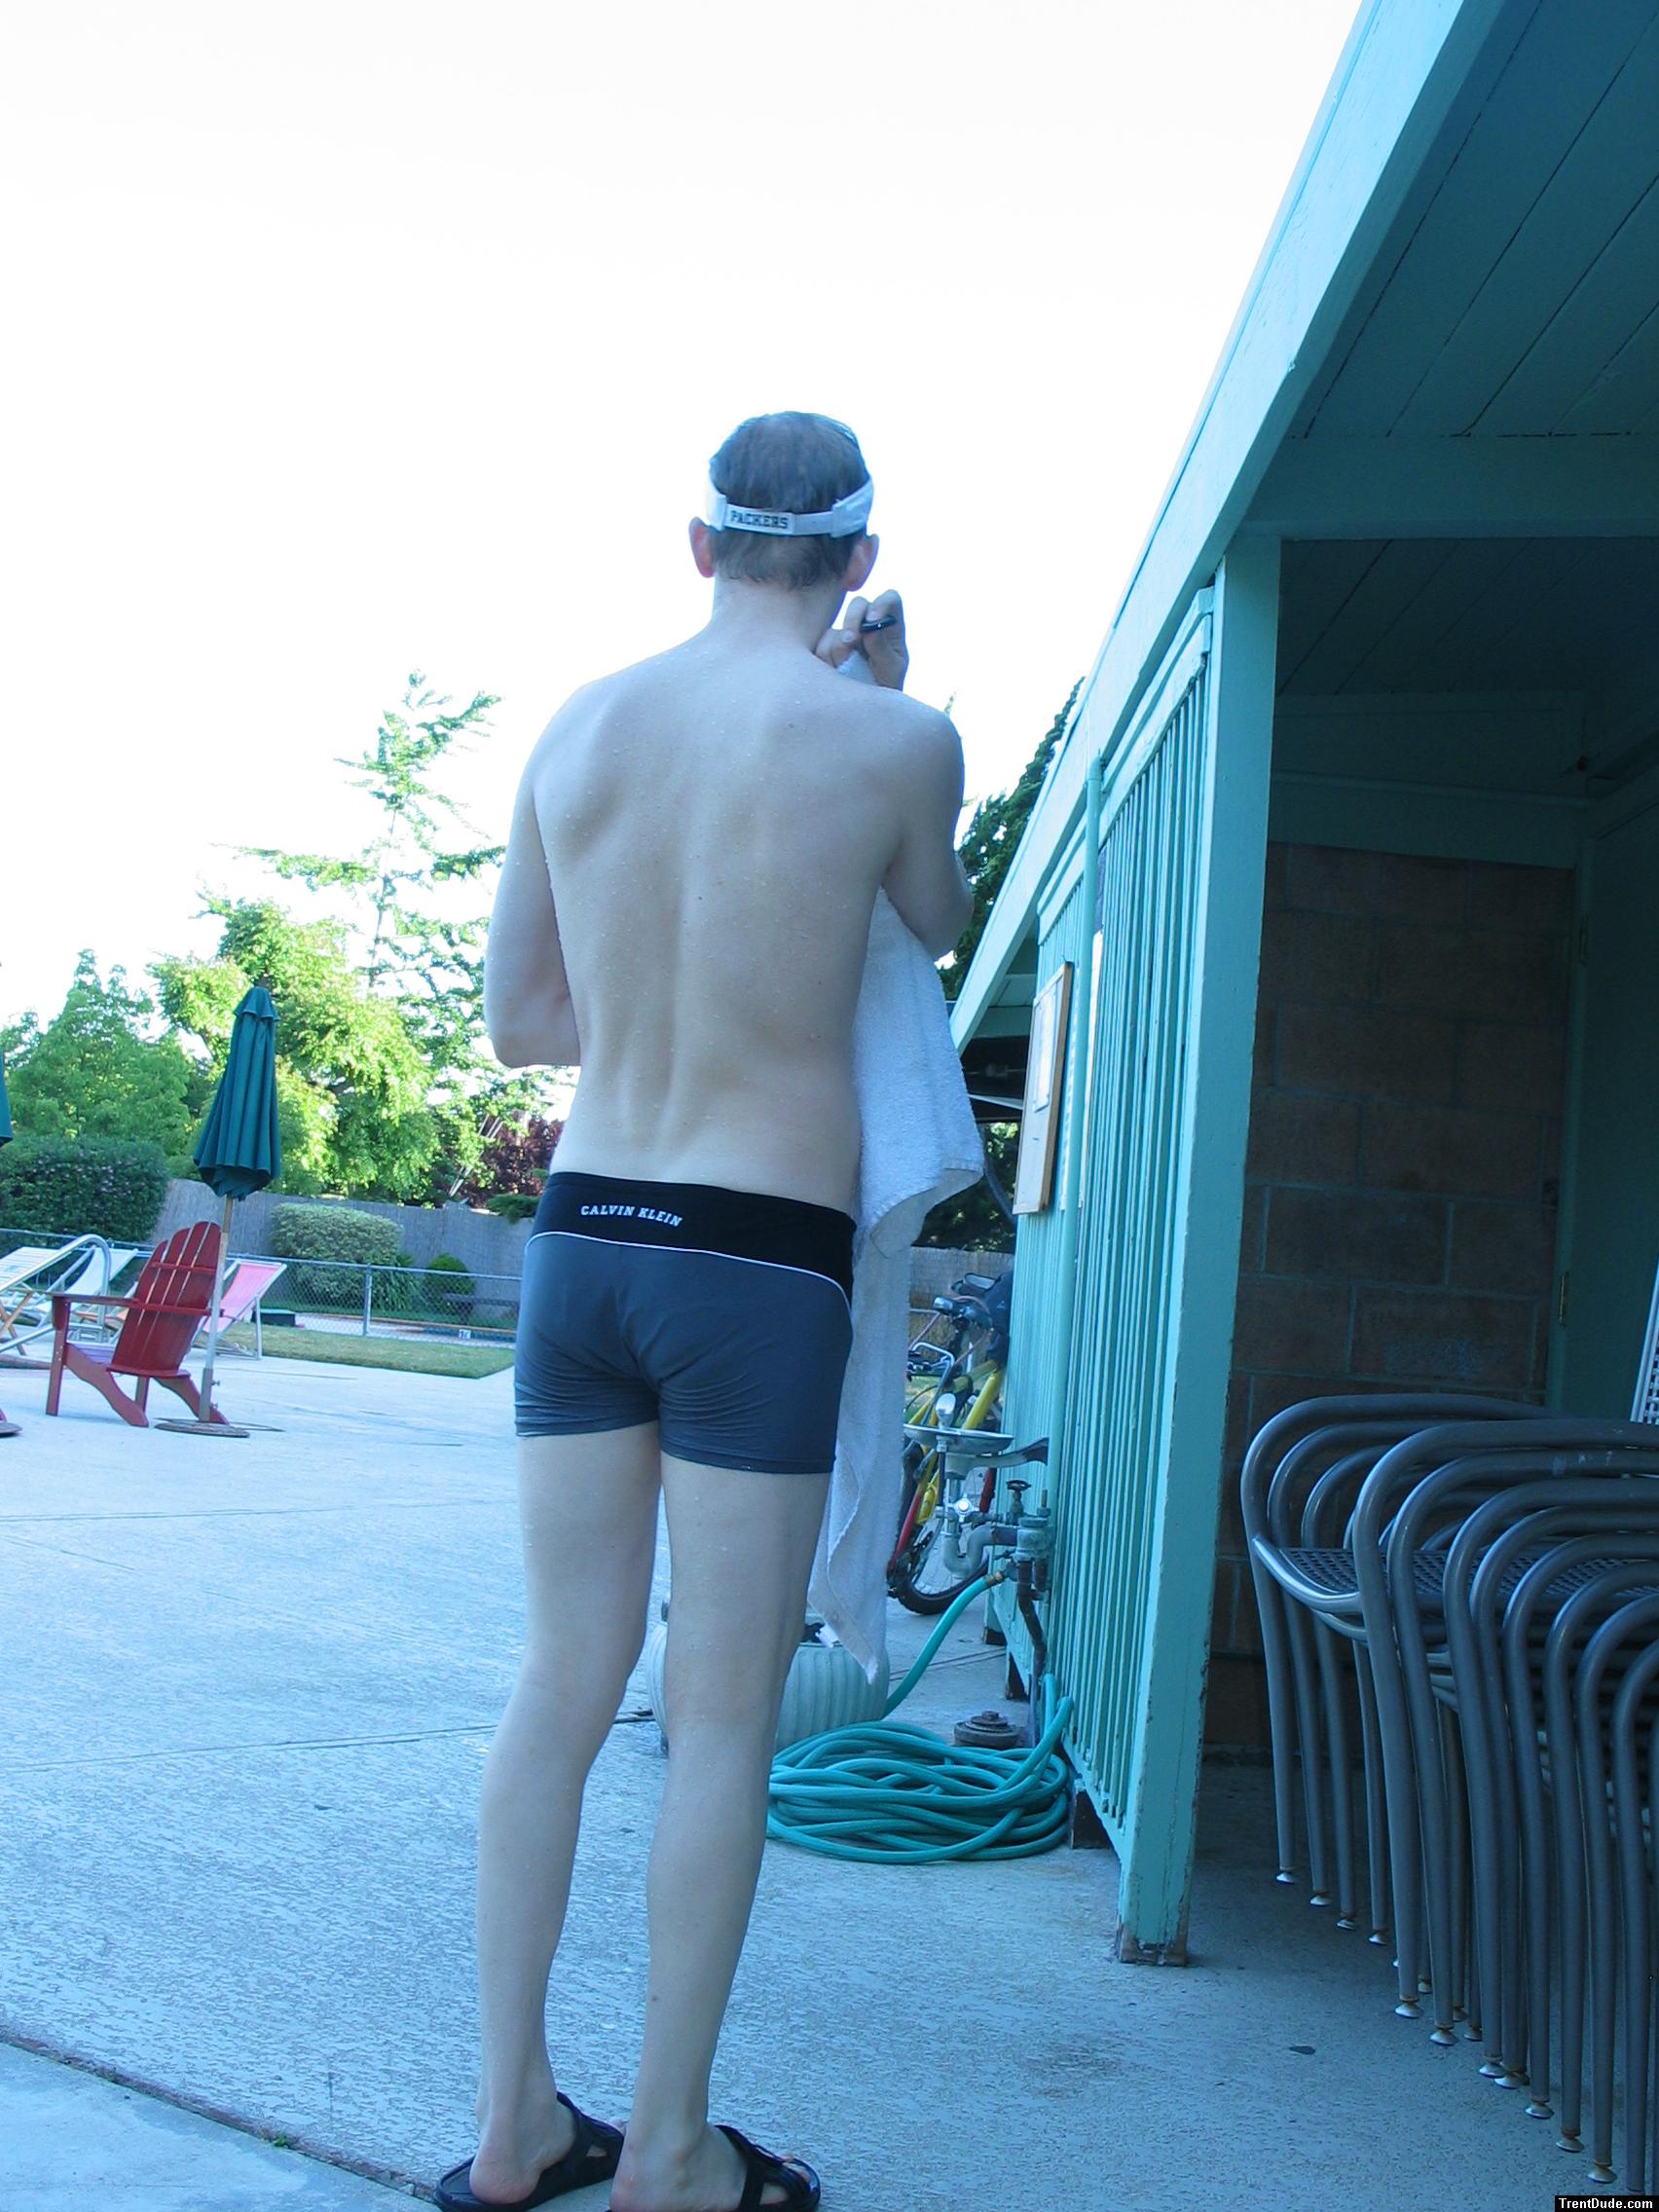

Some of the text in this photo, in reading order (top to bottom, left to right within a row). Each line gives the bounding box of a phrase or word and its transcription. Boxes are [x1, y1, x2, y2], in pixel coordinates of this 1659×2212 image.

[730, 510, 789, 529] PACKERS
[580, 1204, 682, 1227] CALVIN KLEIN
